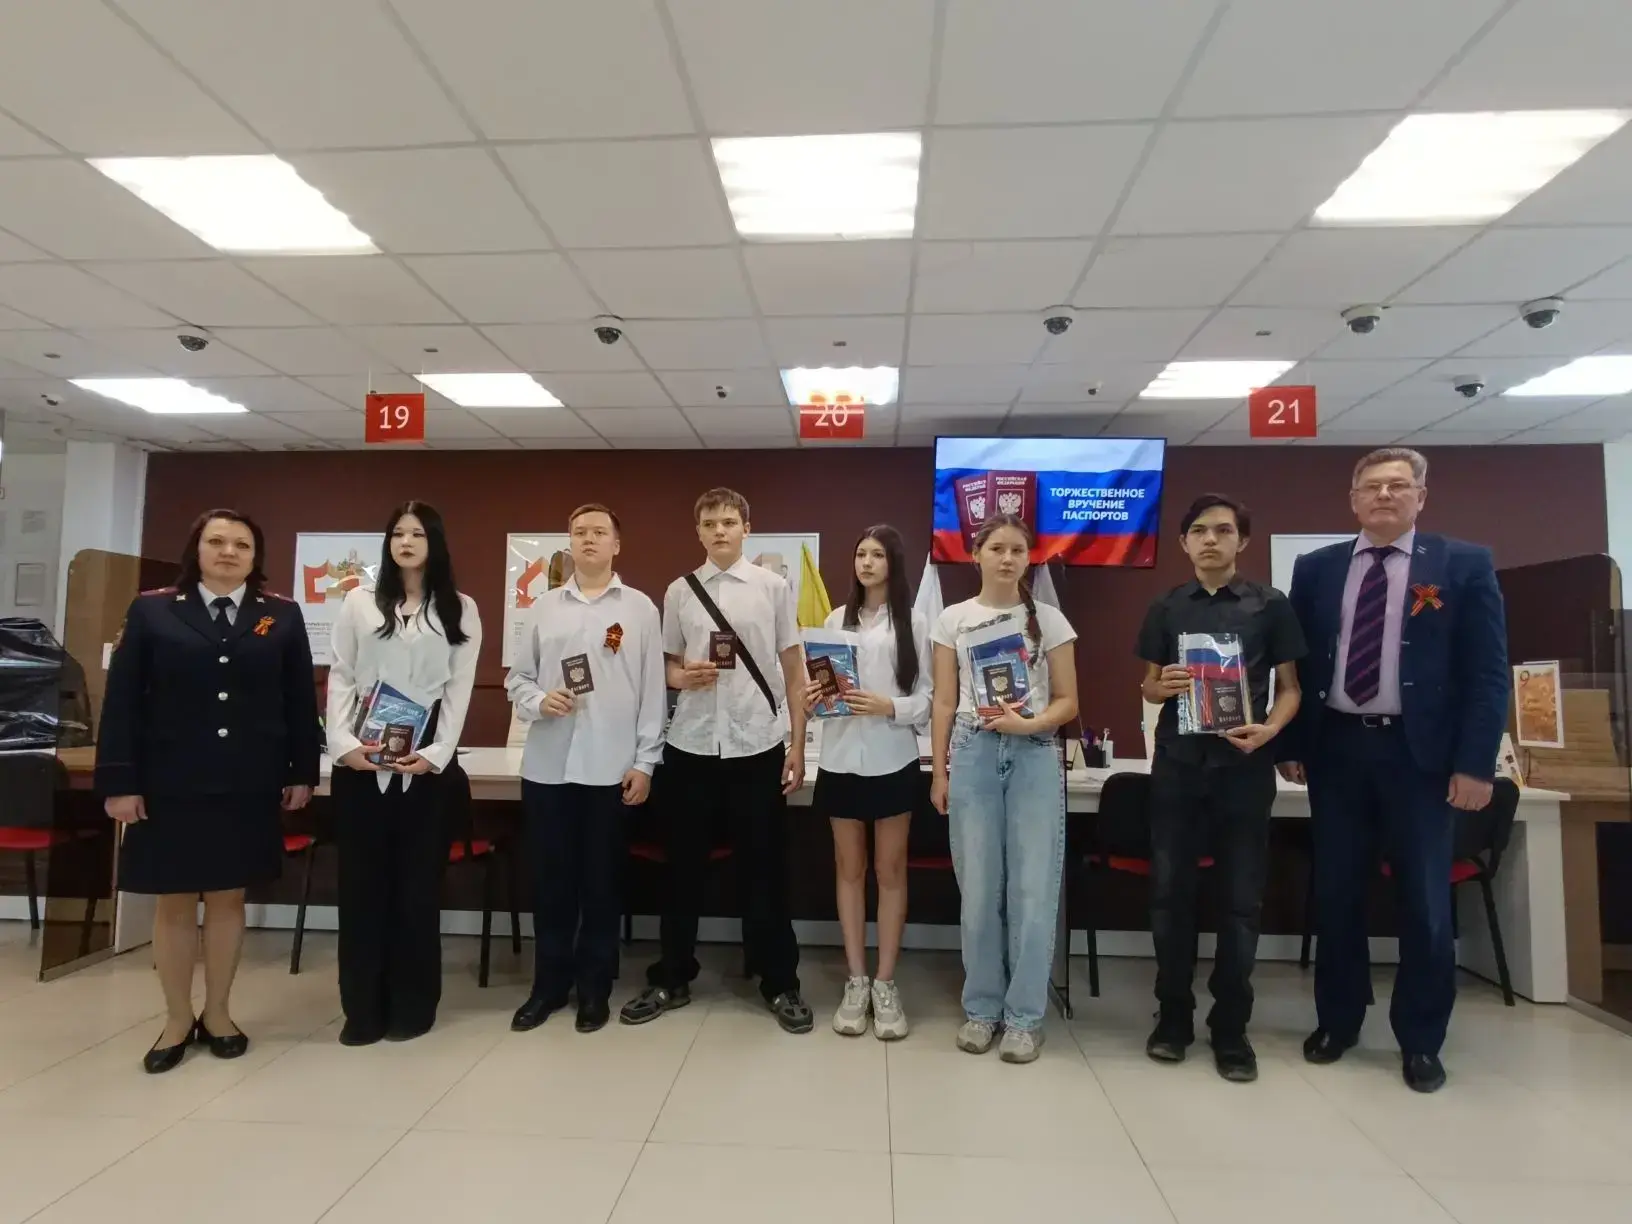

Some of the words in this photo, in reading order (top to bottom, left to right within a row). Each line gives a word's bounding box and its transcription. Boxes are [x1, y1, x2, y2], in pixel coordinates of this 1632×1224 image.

[380, 405, 409, 429] 19
[815, 402, 848, 427] 20
[1268, 399, 1299, 424] 21
[1050, 488, 1145, 498] ТОРЖЕСТВЕННОЕ
[1068, 499, 1125, 509] ВРУЧЕНИЕ
[1062, 511, 1129, 520] ПАСПОРТОВ
